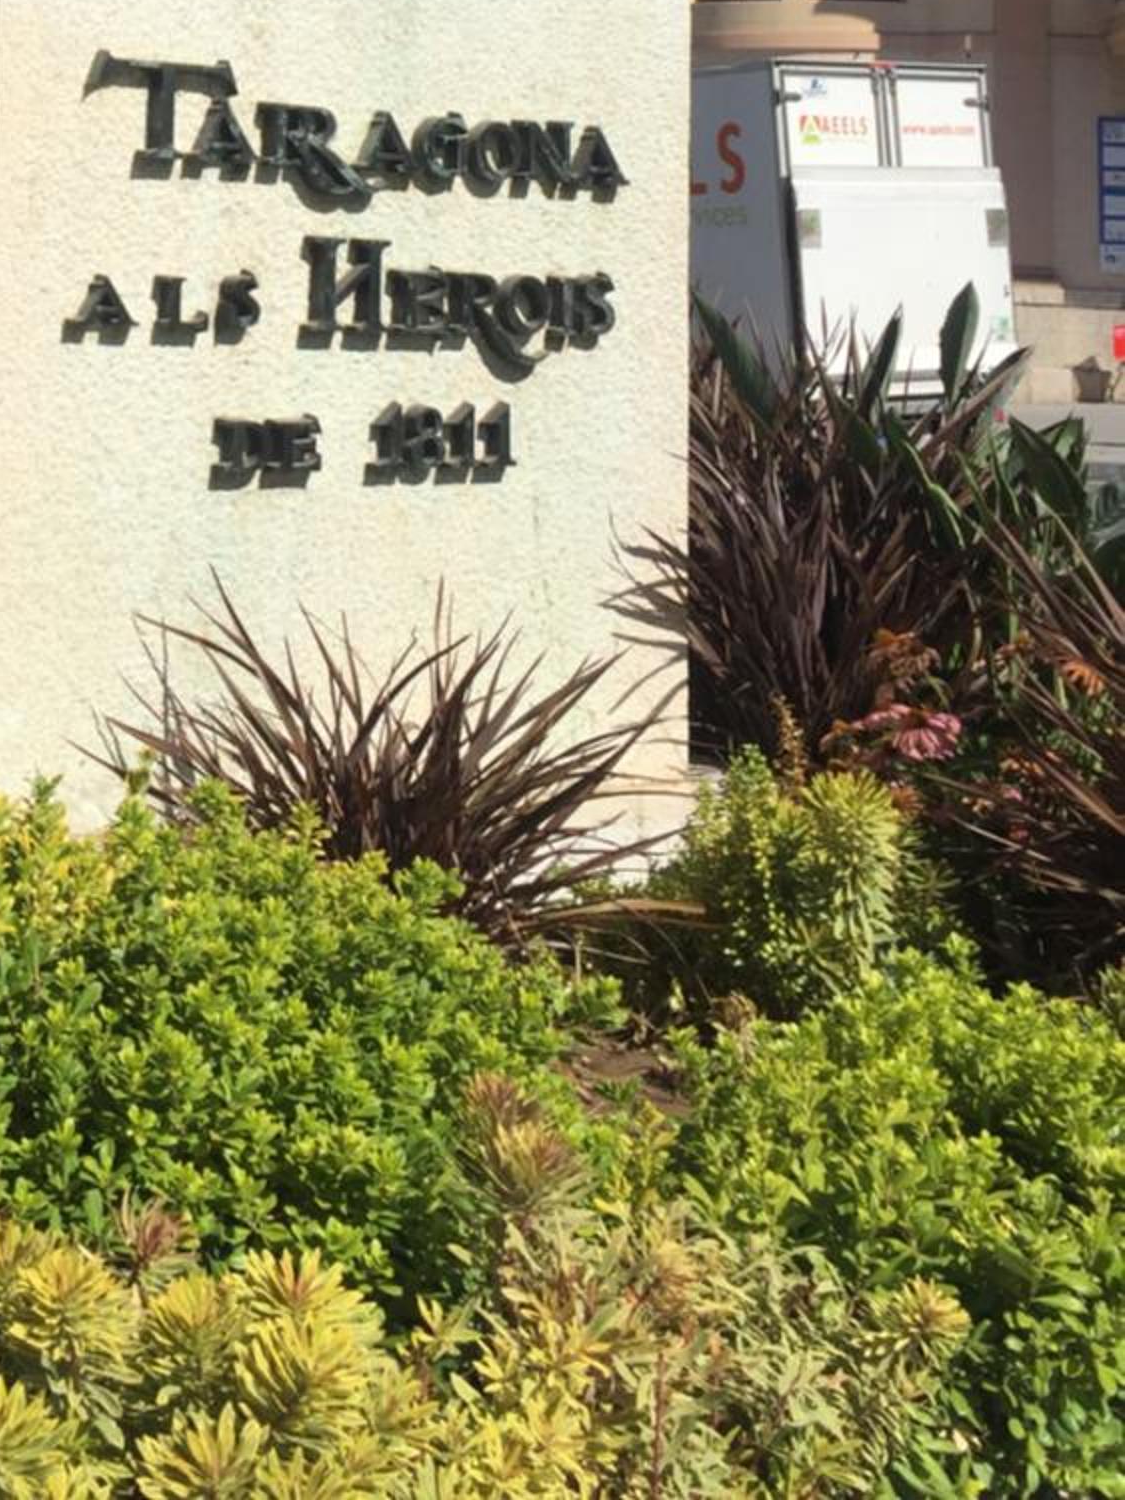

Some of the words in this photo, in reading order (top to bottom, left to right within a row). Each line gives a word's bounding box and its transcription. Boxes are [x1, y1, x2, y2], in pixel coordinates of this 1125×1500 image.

[689, 121, 746, 195] S
[61, 271, 261, 346] ALS
[296, 235, 617, 383] HEROIS
[208, 412, 322, 490] DE
[363, 400, 517, 486] 1811
